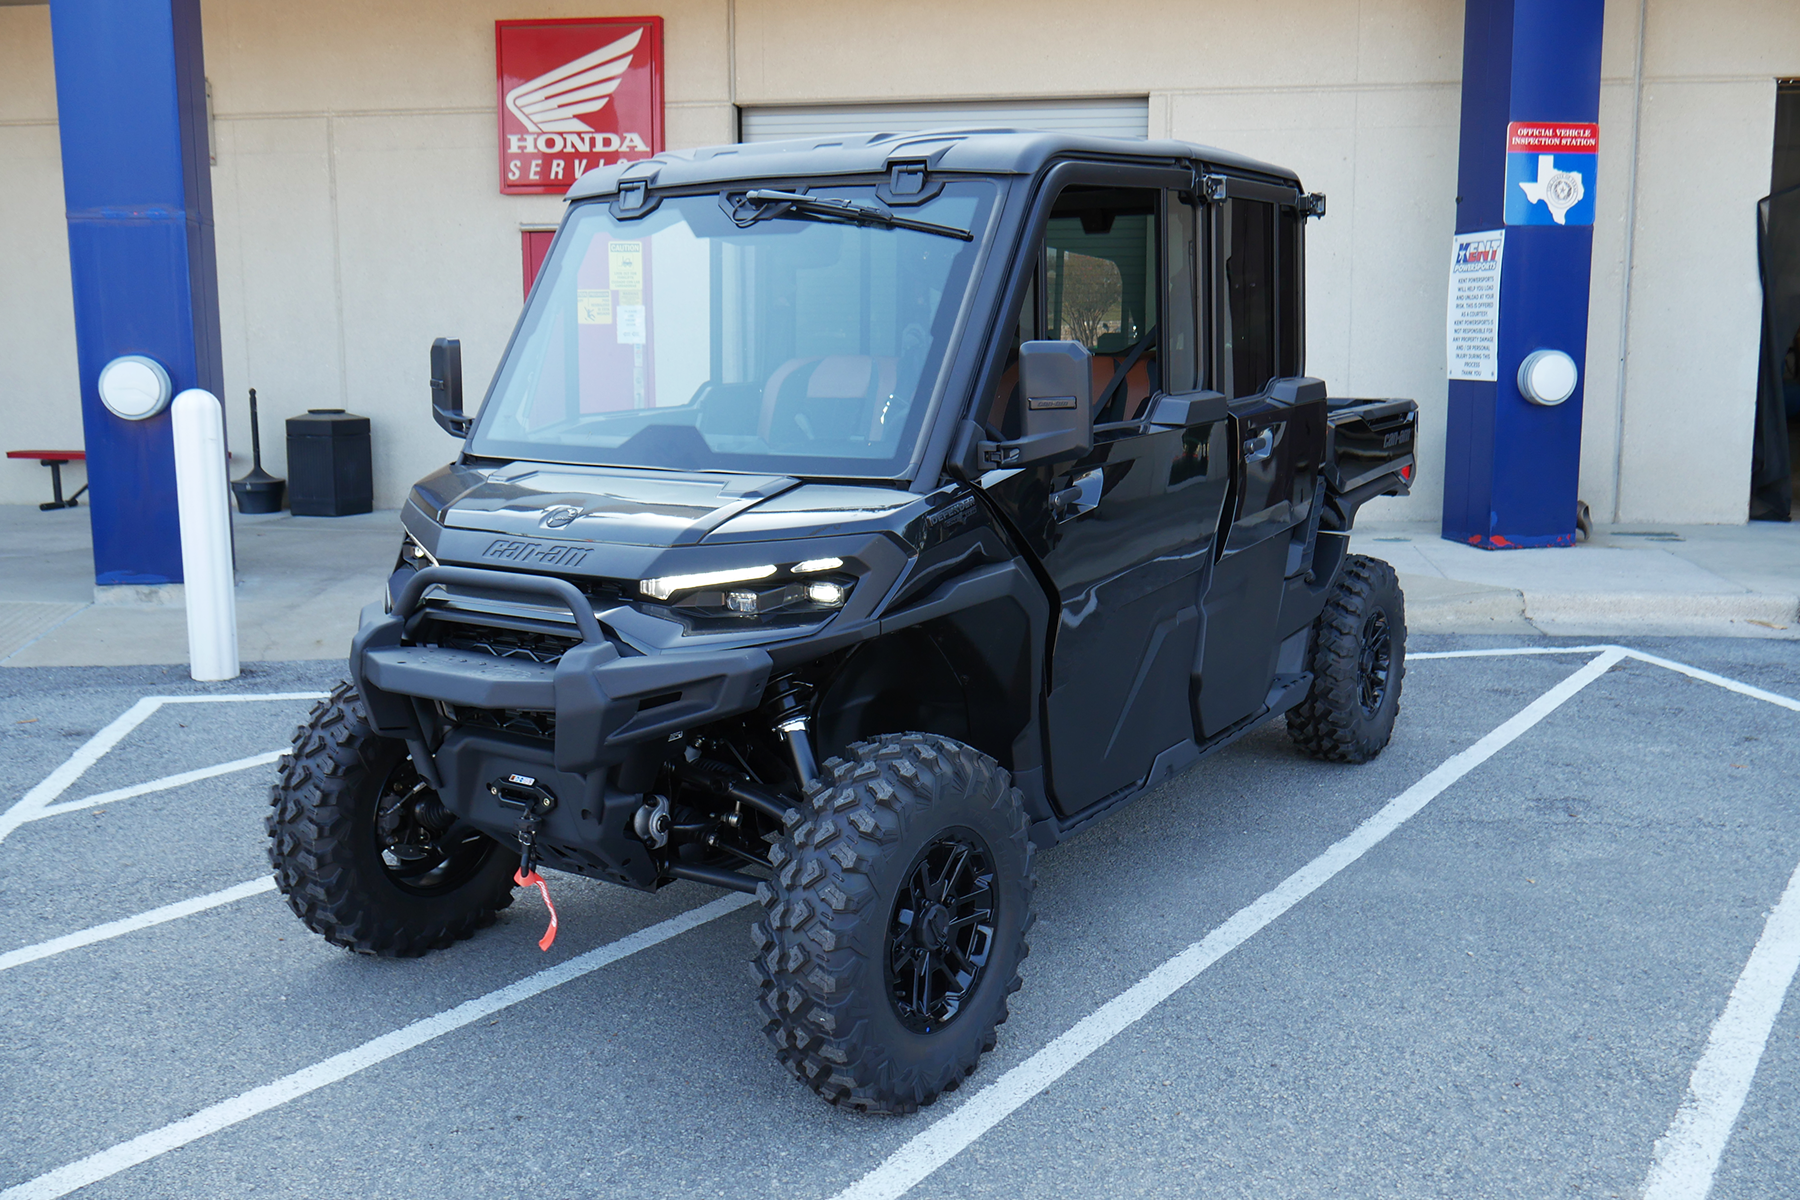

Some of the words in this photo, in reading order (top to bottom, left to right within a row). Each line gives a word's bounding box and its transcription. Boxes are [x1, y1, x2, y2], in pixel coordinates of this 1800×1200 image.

[507, 132, 650, 153] HONDA
[1512, 137, 1560, 146] INSPECTION
[1561, 138, 1597, 146] STATION
[1517, 128, 1554, 136] OFFICIAL
[1556, 129, 1592, 137] VEHICLE
[508, 158, 640, 180] SERV
[611, 244, 640, 252] CAUTION
[1456, 239, 1502, 264] KENT
[1454, 261, 1497, 273] POWERSPORTS
[1383, 428, 1411, 448] can-am
[930, 497, 976, 525] DEFENDER
[482, 539, 595, 568] can-am
